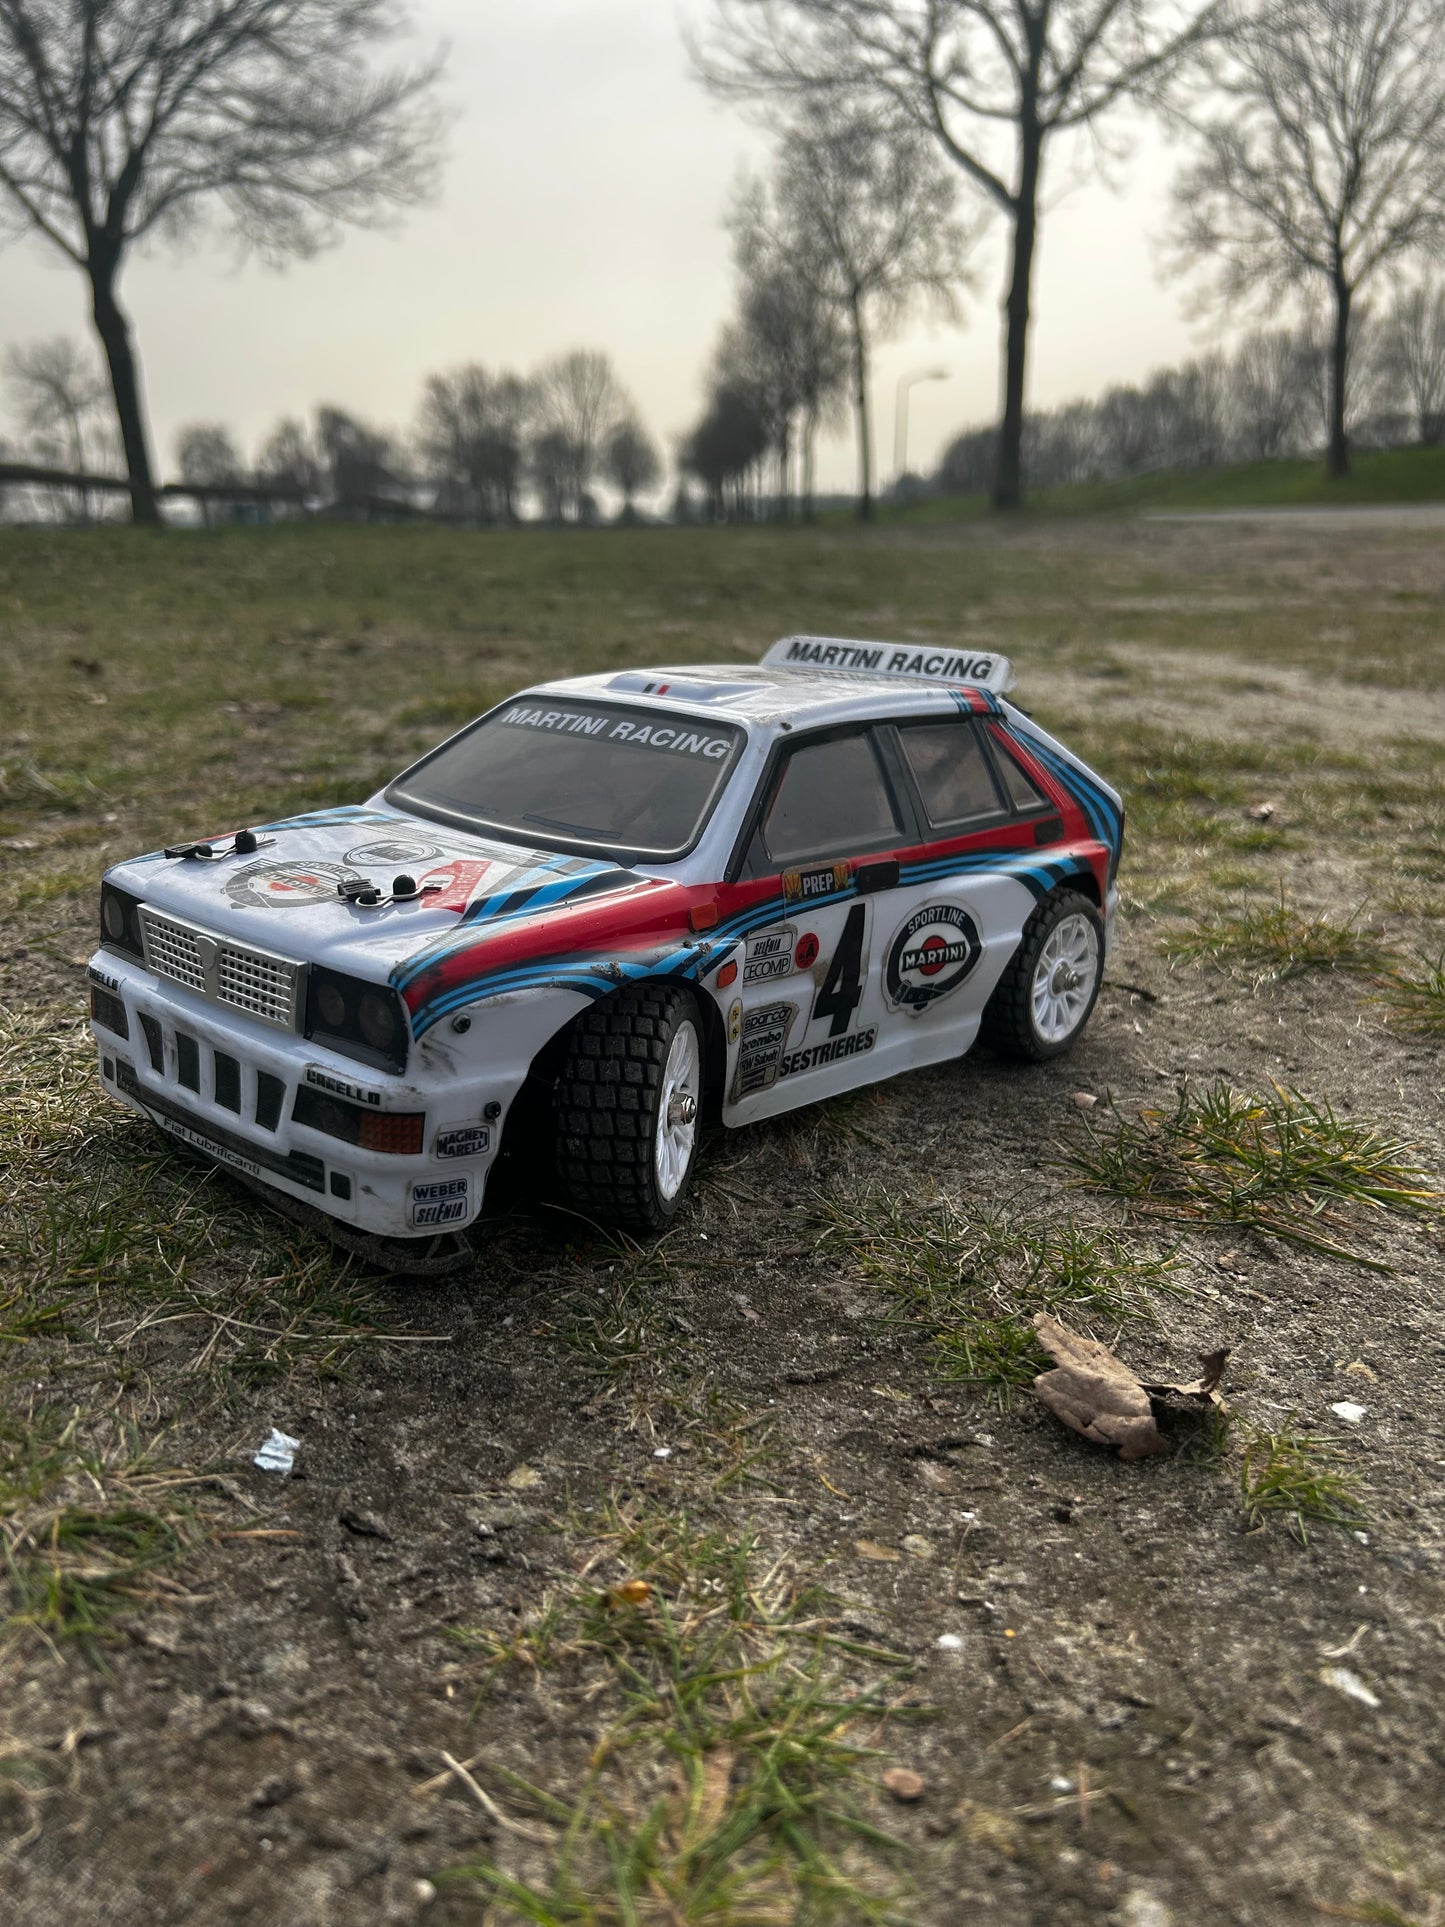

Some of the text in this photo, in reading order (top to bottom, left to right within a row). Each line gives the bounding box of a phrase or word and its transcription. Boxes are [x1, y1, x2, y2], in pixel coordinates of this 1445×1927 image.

[786, 643, 993, 680] MARTINI RACING
[501, 707, 729, 759] MARTINI RACING
[803, 872, 834, 895] PREP
[907, 907, 965, 934] SPORTLINE
[744, 957, 789, 979] CECOMP
[905, 945, 964, 969] MARTINI
[812, 903, 866, 1038] 4
[744, 1007, 788, 1032] sparco
[741, 1031, 783, 1054] brembo
[780, 1028, 875, 1077] SESTRIERES
[164, 1117, 261, 1176] Fiat Lubrificanti
[438, 1134, 488, 1156] MARELLI
[415, 1181, 466, 1199] WEBER
